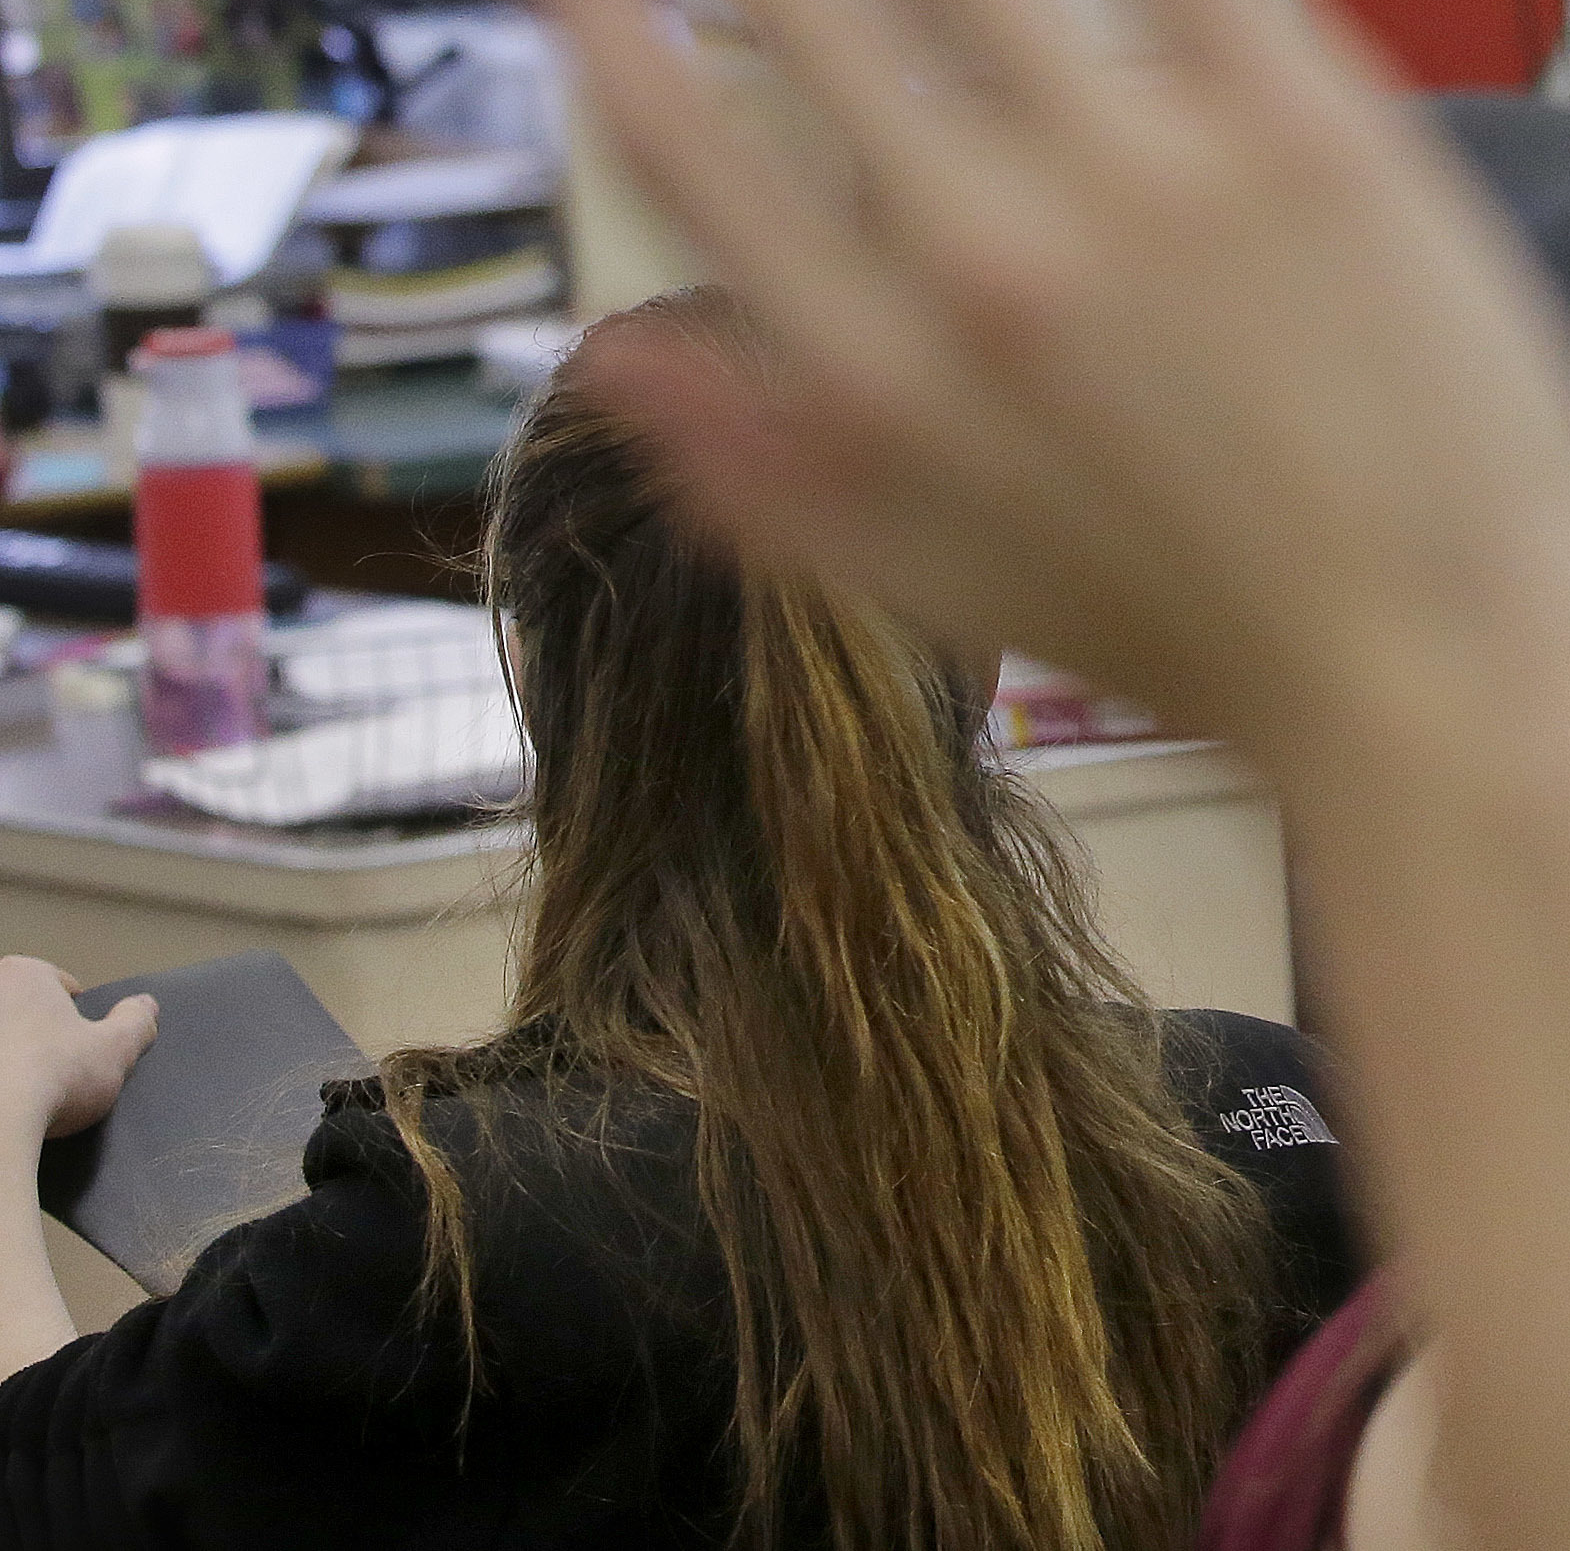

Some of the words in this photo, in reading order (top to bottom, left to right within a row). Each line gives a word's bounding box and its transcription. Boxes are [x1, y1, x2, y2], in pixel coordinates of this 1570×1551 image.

[1241, 1086, 1281, 1107] THE
[1219, 1105, 1297, 1133] NORTH
[1250, 1125, 1309, 1151] FACE
